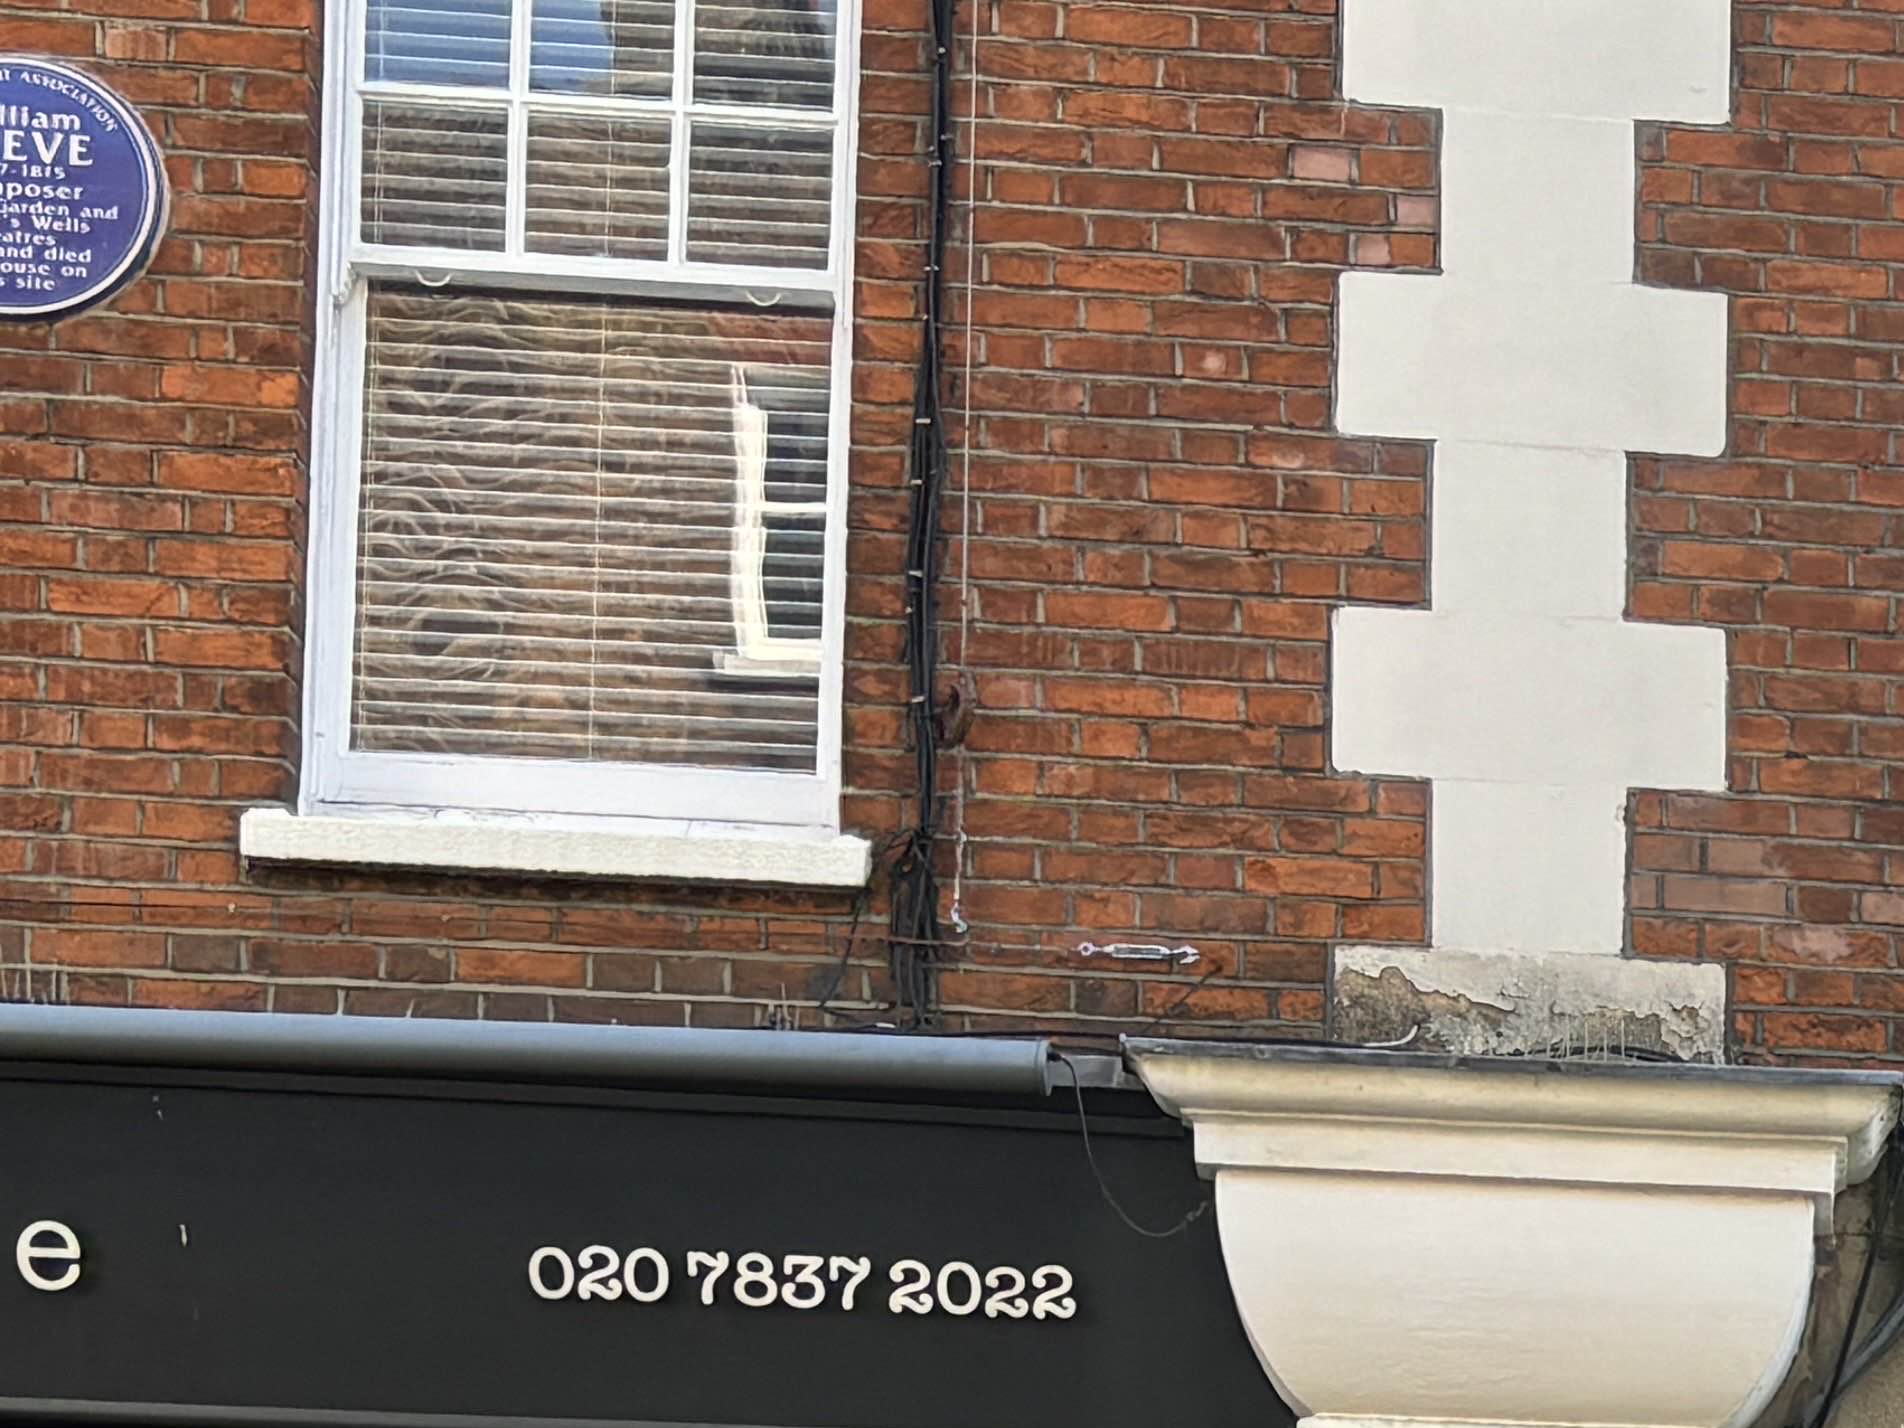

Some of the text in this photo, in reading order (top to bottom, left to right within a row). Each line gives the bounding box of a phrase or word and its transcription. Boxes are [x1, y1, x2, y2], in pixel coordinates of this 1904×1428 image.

[3, 129, 93, 166] EVE
[80, 205, 118, 219] and
[31, 215, 91, 234] Wells
[0, 231, 56, 246] atres
[44, 246, 92, 263] died
[61, 265, 87, 278] on
[16, 274, 56, 291] site
[16, 1219, 81, 1291] e
[529, 1245, 1077, 1320] 020 7837 2022
